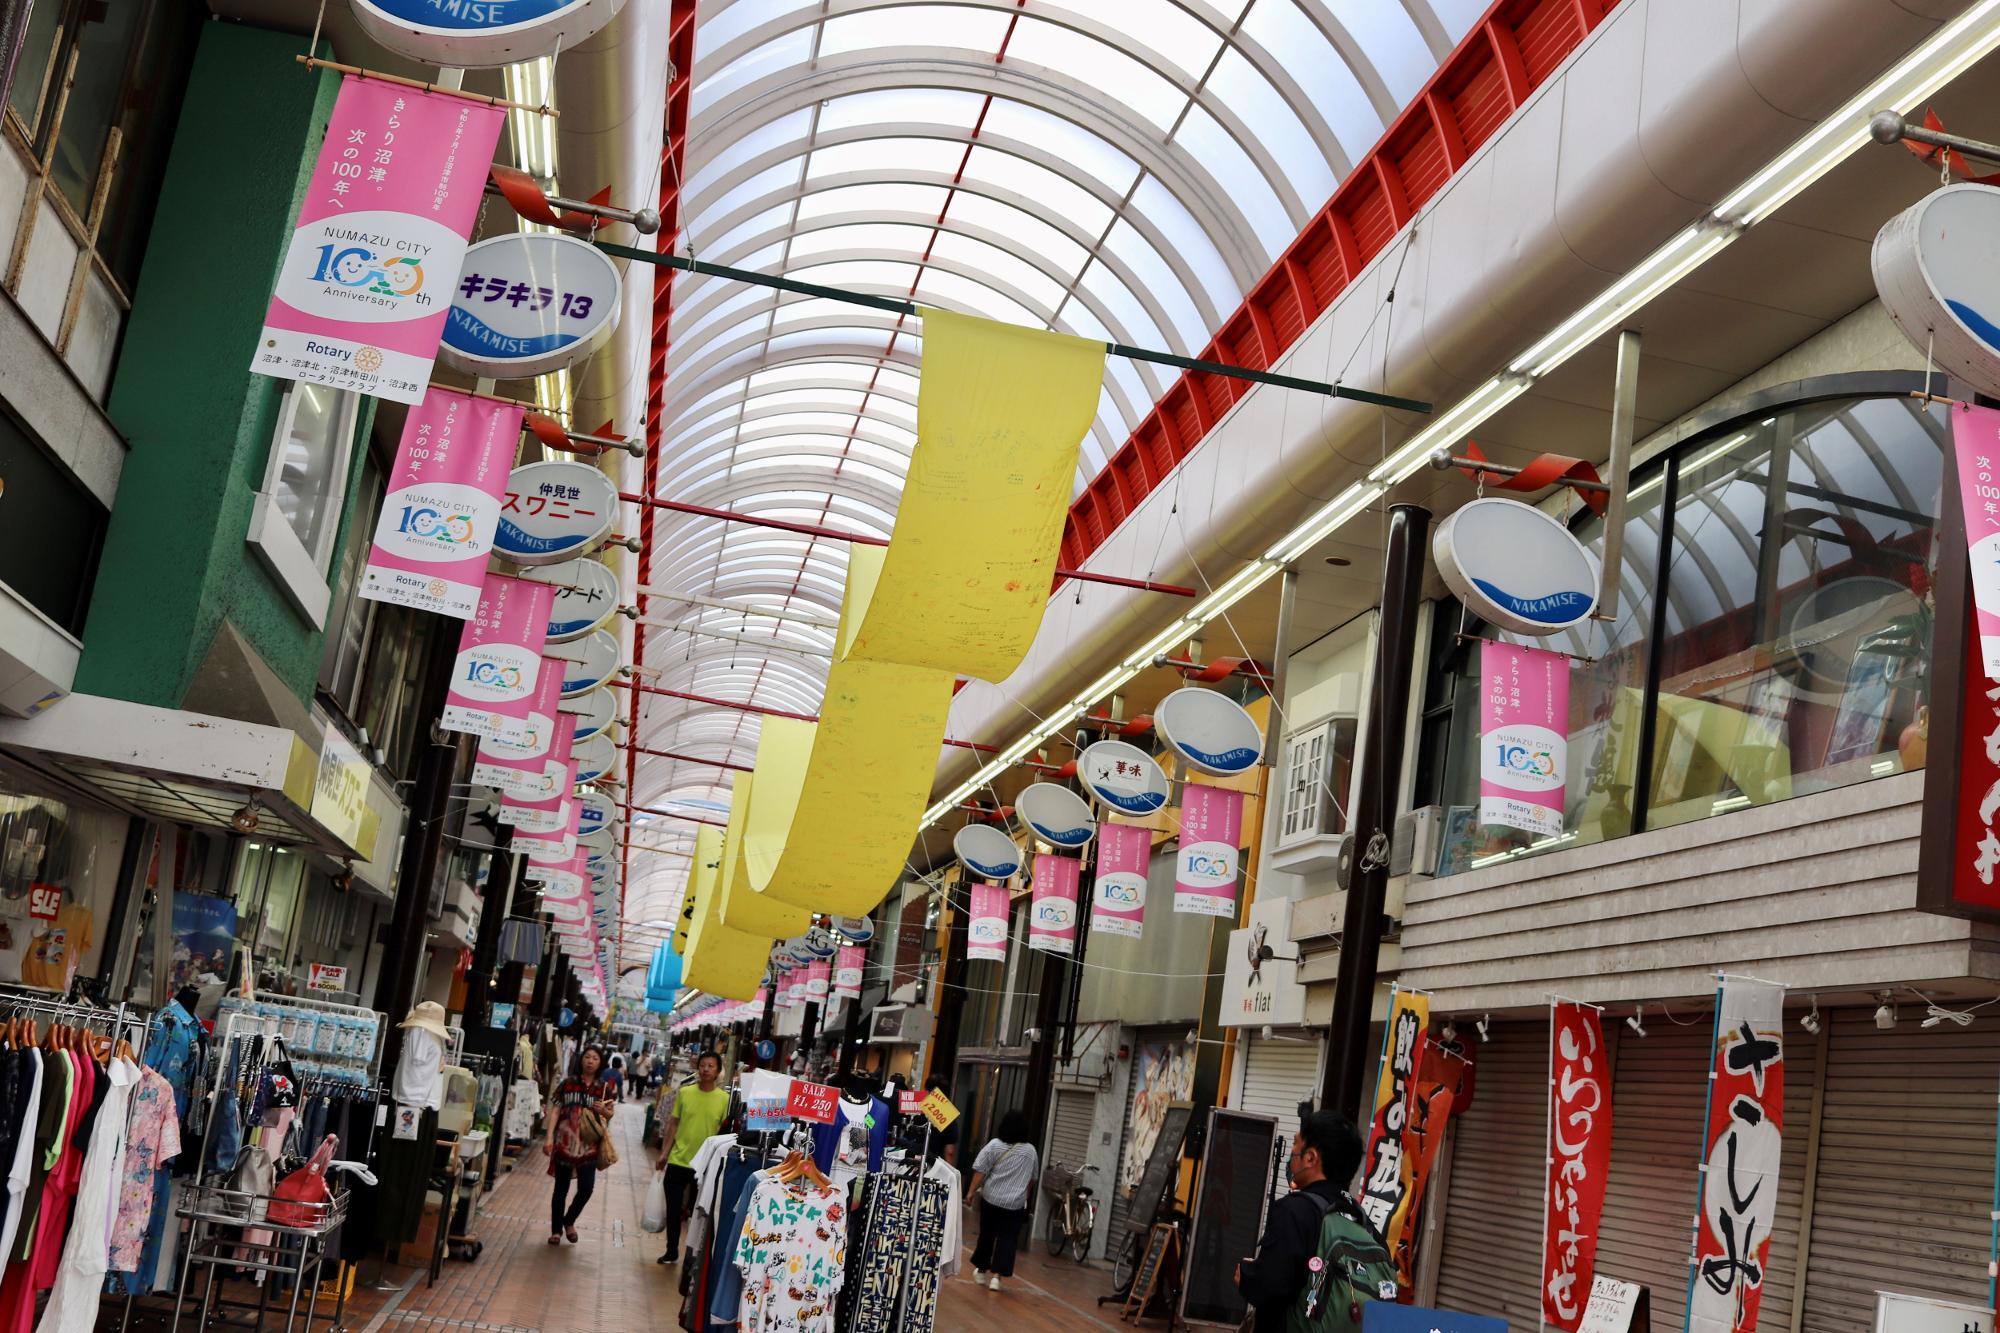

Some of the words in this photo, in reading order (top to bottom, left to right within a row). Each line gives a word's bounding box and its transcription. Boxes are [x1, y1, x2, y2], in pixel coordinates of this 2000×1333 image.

[367, 97, 406, 192] きらり沼津。
[328, 128, 367, 209] 次の100年へ
[324, 226, 390, 247] NUMAZU
[396, 240, 432, 256] CITY
[323, 286, 398, 310] Anniversary
[415, 292, 432, 306] th
[459, 273, 554, 312] キラキラ
[560, 292, 593, 319] 13
[449, 307, 530, 354] NAKAMISE
[306, 340, 352, 361] Rotary
[298, 371, 377, 392] ロータリークラブ
[407, 423, 432, 481] 次の100年へ
[539, 482, 581, 500] 仲見世
[405, 493, 450, 509] NUMAZU
[454, 503, 479, 513] CITY
[501, 492, 596, 519] スワニー
[406, 535, 457, 553] Anniversary
[395, 575, 427, 589] Rotary
[1510, 592, 1579, 614] NAKAMISE
[1497, 734, 1533, 746] NUMAZU
[1202, 749, 1249, 765] NAKAMISE
[1115, 760, 1142, 777] 華味
[1507, 802, 1532, 815] Rotary
[804, 929, 829, 949] 4G
[1254, 991, 1271, 1013] flat
[802, 1083, 827, 1098] SALE
[1548, 1016, 1601, 1321] いらっしゃいませ
